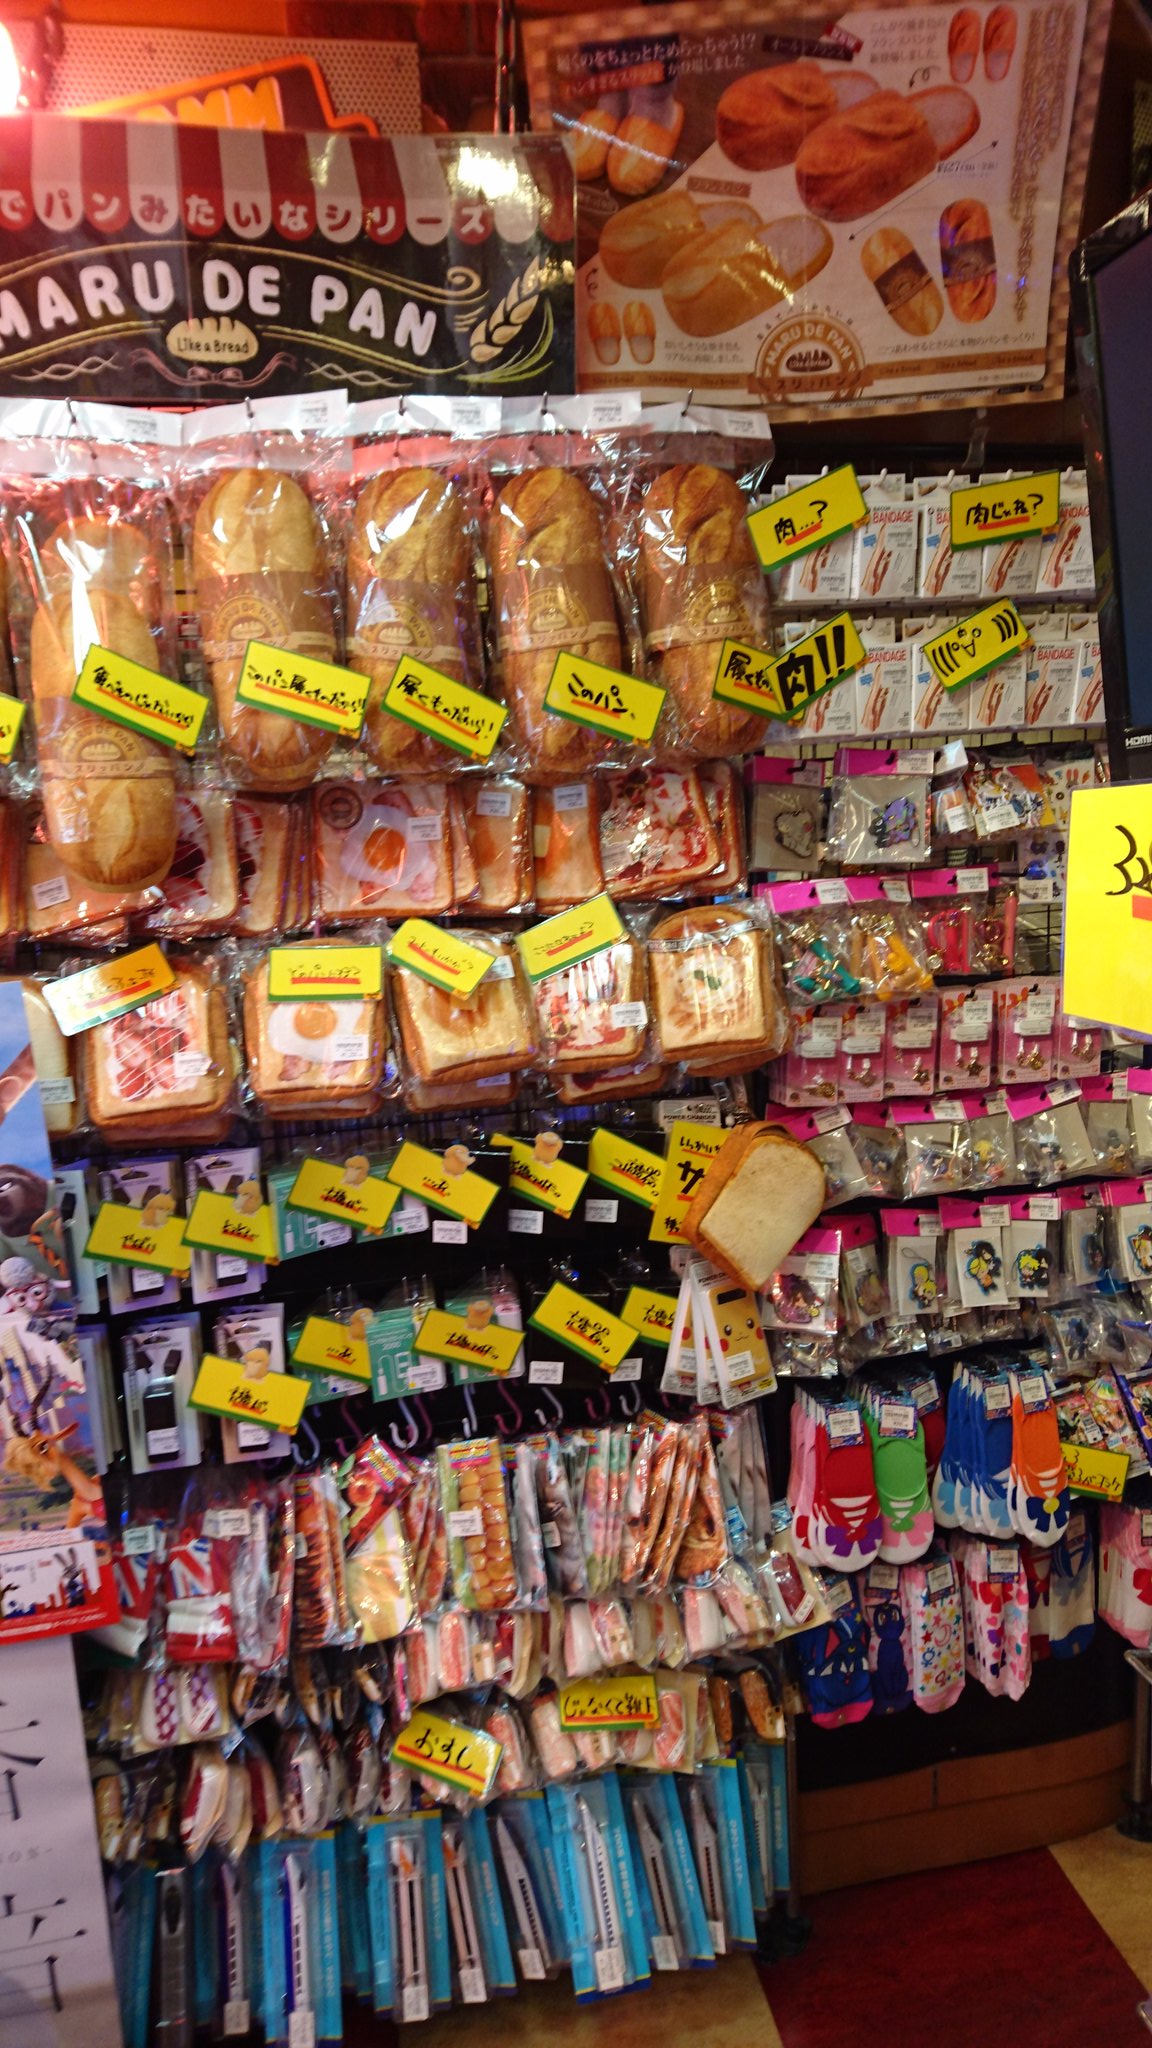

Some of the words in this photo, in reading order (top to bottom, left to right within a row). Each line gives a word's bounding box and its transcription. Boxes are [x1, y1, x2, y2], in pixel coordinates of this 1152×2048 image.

[203, 259, 281, 316] DE
[311, 274, 437, 356] PAN
[204, 342, 212, 354] a
[765, 325, 801, 367] MARU
[804, 322, 826, 337] DE
[826, 328, 852, 360] PAN
[873, 510, 914, 524] BANDAGE
[868, 650, 907, 663] BANDAGE
[1037, 648, 1075, 661] BANDAGE
